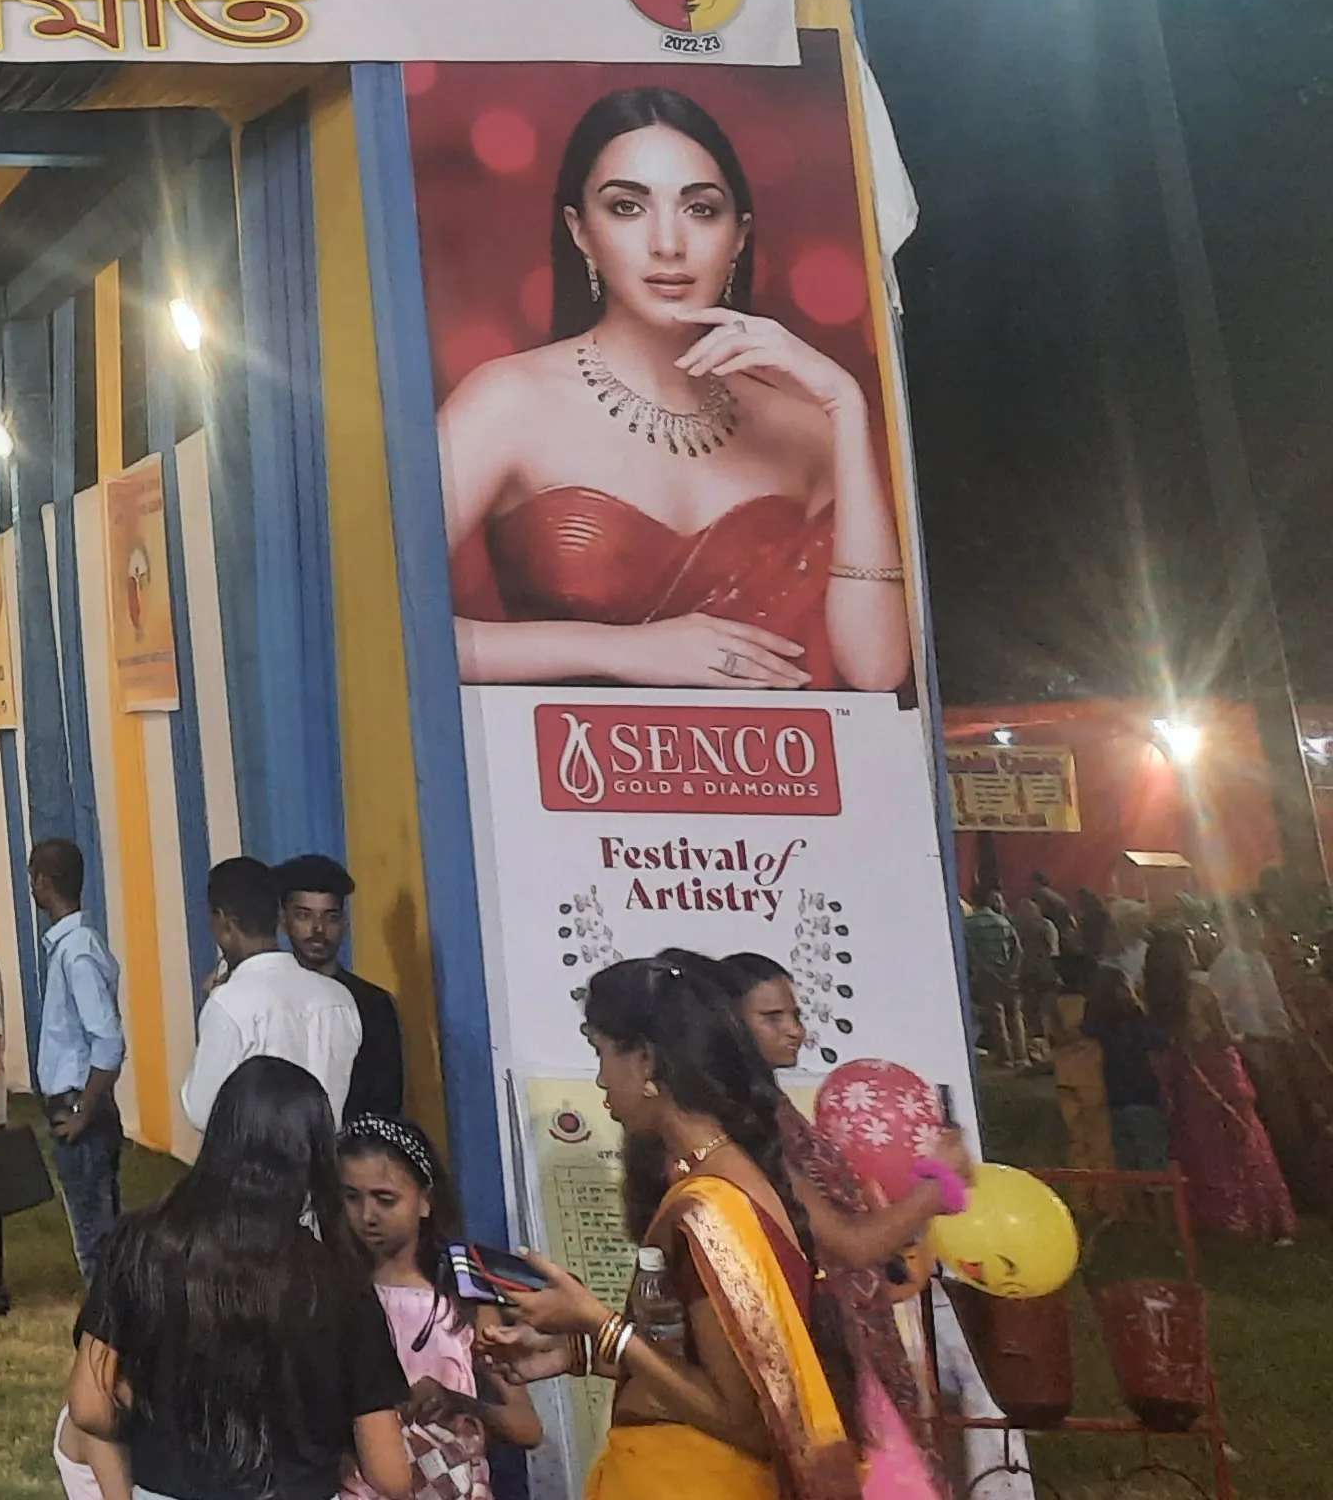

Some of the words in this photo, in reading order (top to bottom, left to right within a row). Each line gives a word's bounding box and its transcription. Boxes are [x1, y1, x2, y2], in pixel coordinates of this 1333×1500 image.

[663, 34, 721, 52] 2022-23
[608, 723, 817, 778] SENCO
[613, 780, 672, 795] GOLD
[682, 780, 695, 795] &
[704, 781, 820, 797] DIAMONDS
[597, 836, 749, 872] Festival
[753, 838, 808, 887] of
[625, 876, 784, 922] Artistry
